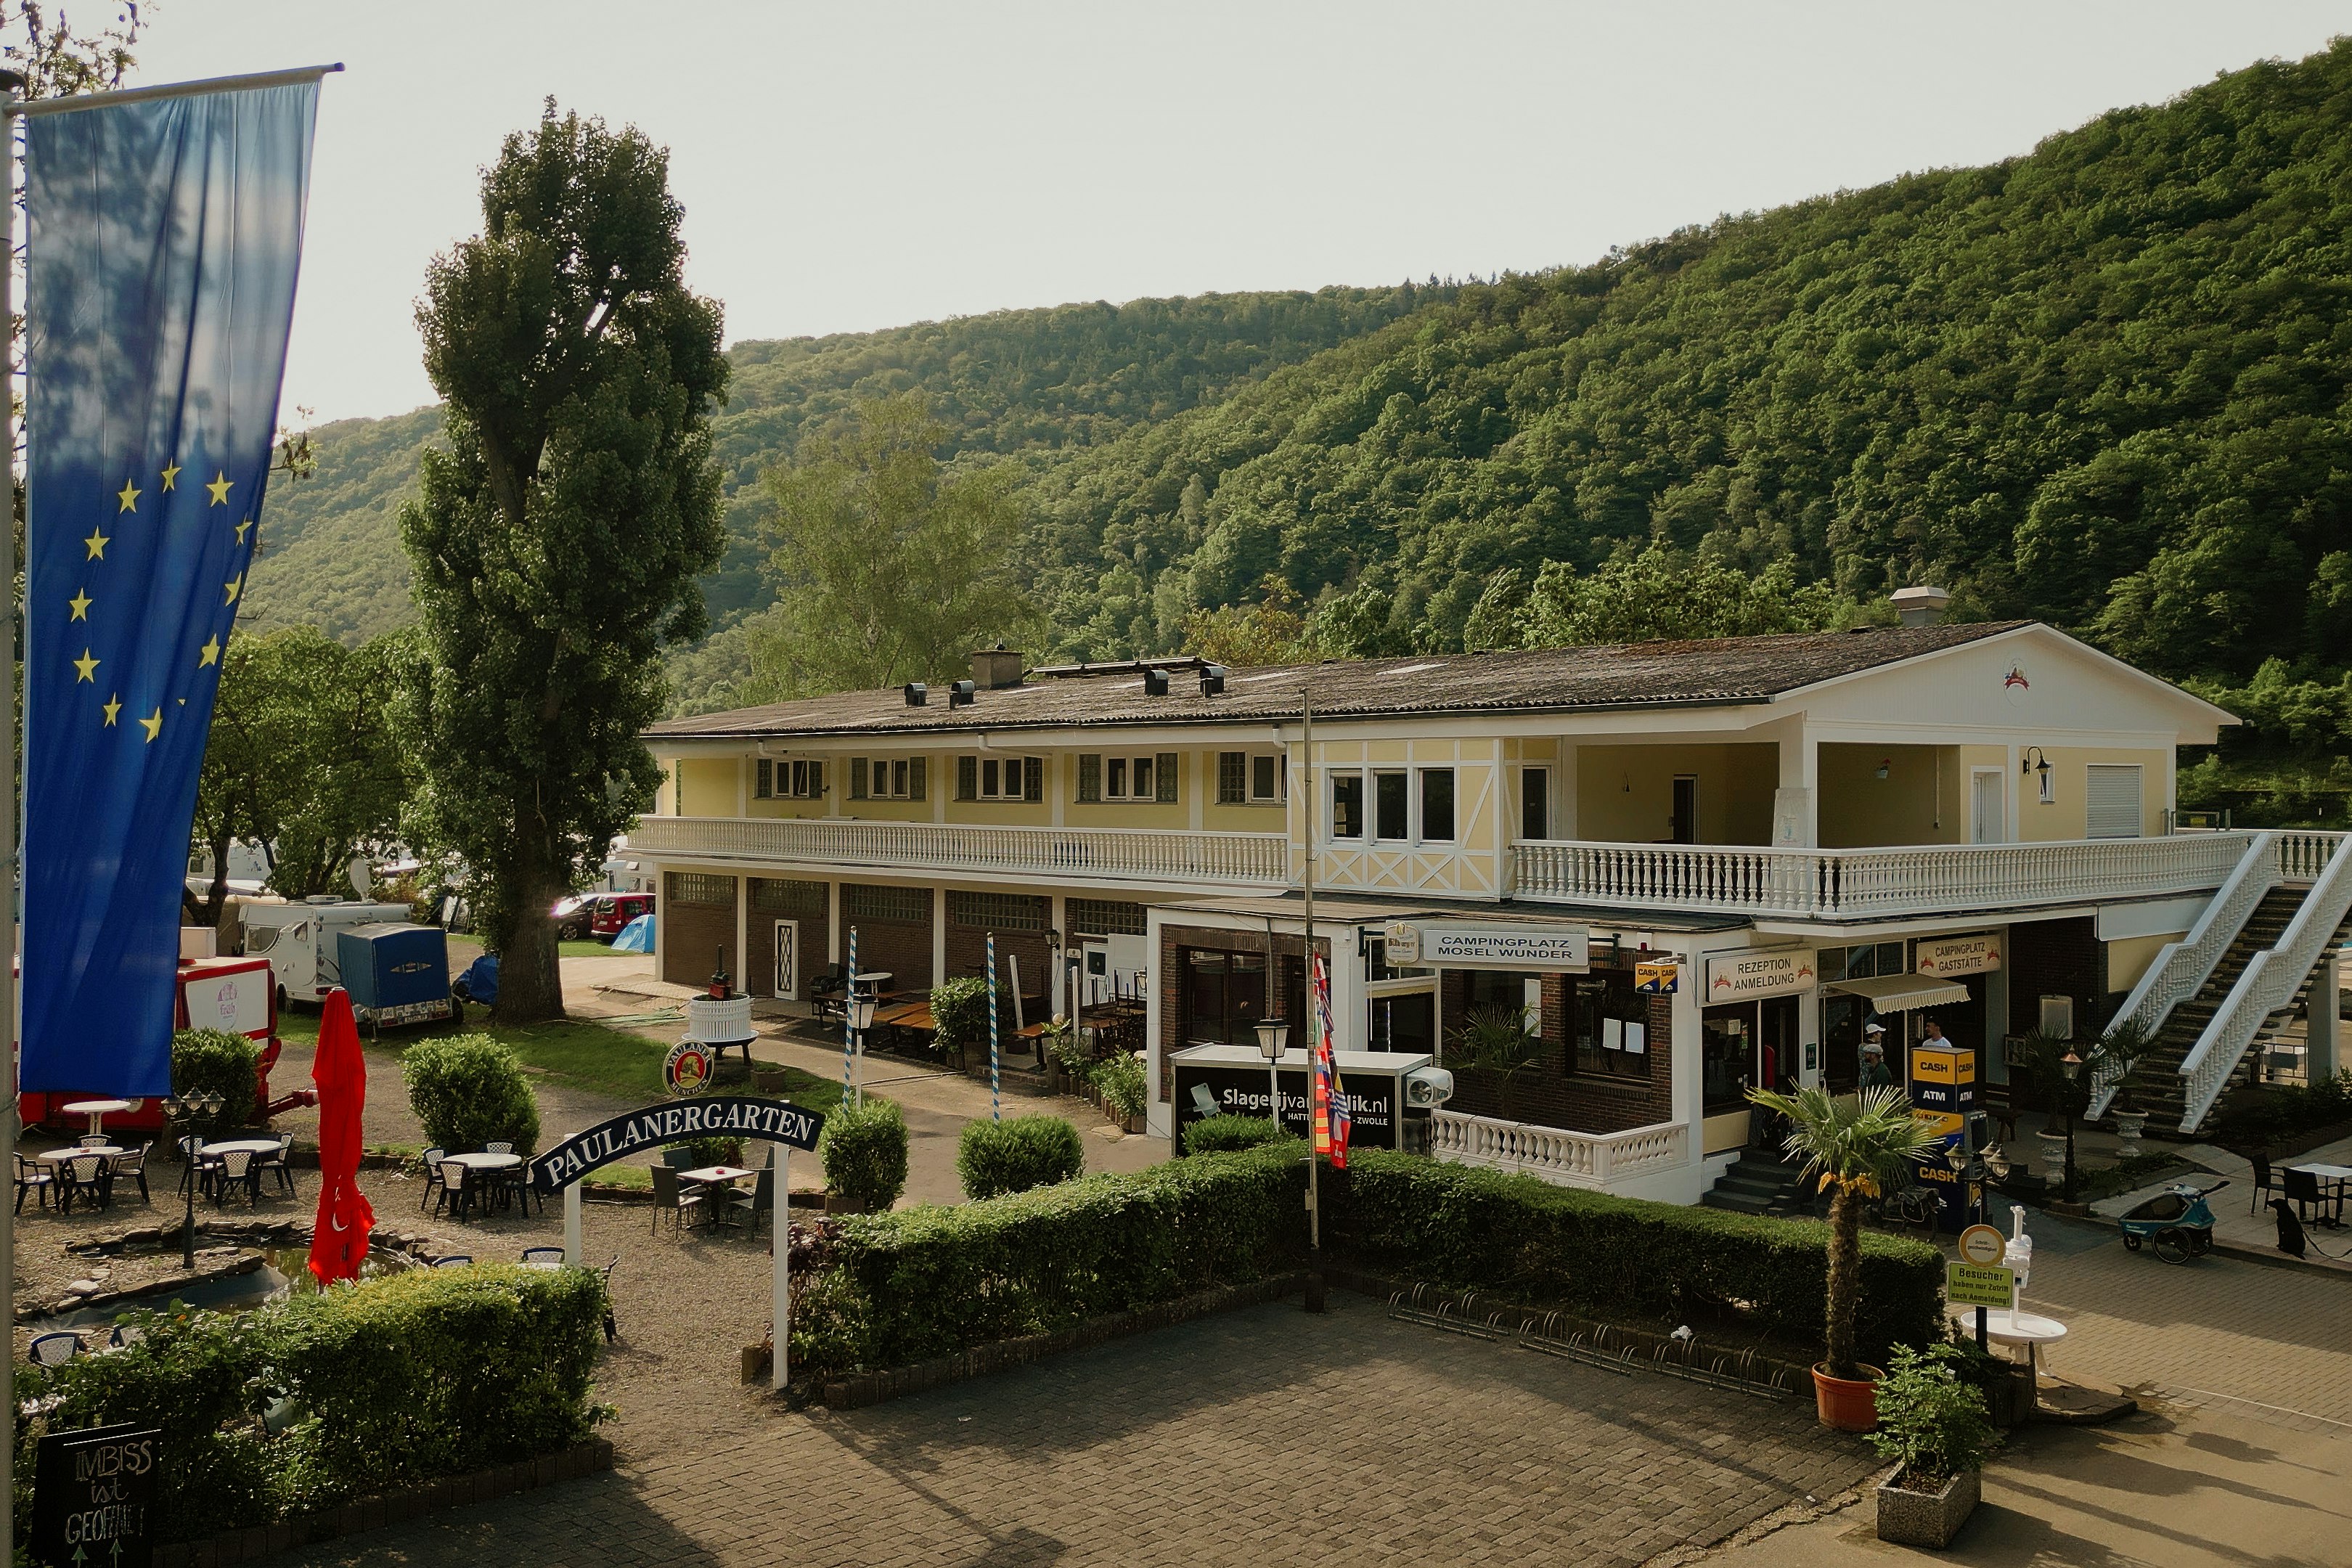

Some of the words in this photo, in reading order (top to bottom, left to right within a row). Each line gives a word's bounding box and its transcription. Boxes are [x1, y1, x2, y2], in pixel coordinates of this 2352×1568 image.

[1441, 936, 1569, 948] CAMPINGPLATZ
[1438, 947, 1494, 957] MOSEL
[1498, 948, 1573, 959] WUNDER
[1935, 942, 1985, 957] CAMPINGPLATZ
[1738, 958, 1791, 975] REZEPTION
[1938, 956, 1983, 971] GASTSTÄTTE
[1638, 968, 1658, 977] CASH
[1734, 973, 1794, 991] ANMELDUNG
[667, 1042, 711, 1067] PAULANER
[1920, 1061, 1948, 1073] CASH
[1958, 1063, 1973, 1074] CASH
[1922, 1090, 1945, 1101] ATM
[1959, 1090, 1972, 1102] ATM
[1357, 1116, 1388, 1126] ZWOLLE
[544, 1103, 815, 1187] PAULANERGARTEN
[1919, 1167, 1957, 1183] CASH
[1959, 1267, 2004, 1281] Besucher
[1988, 1283, 2009, 1292] Zutritt
[1969, 1293, 2010, 1305] Anmeldung!
[75, 1440, 152, 1482] IMBISS
[91, 1477, 129, 1503] ist
